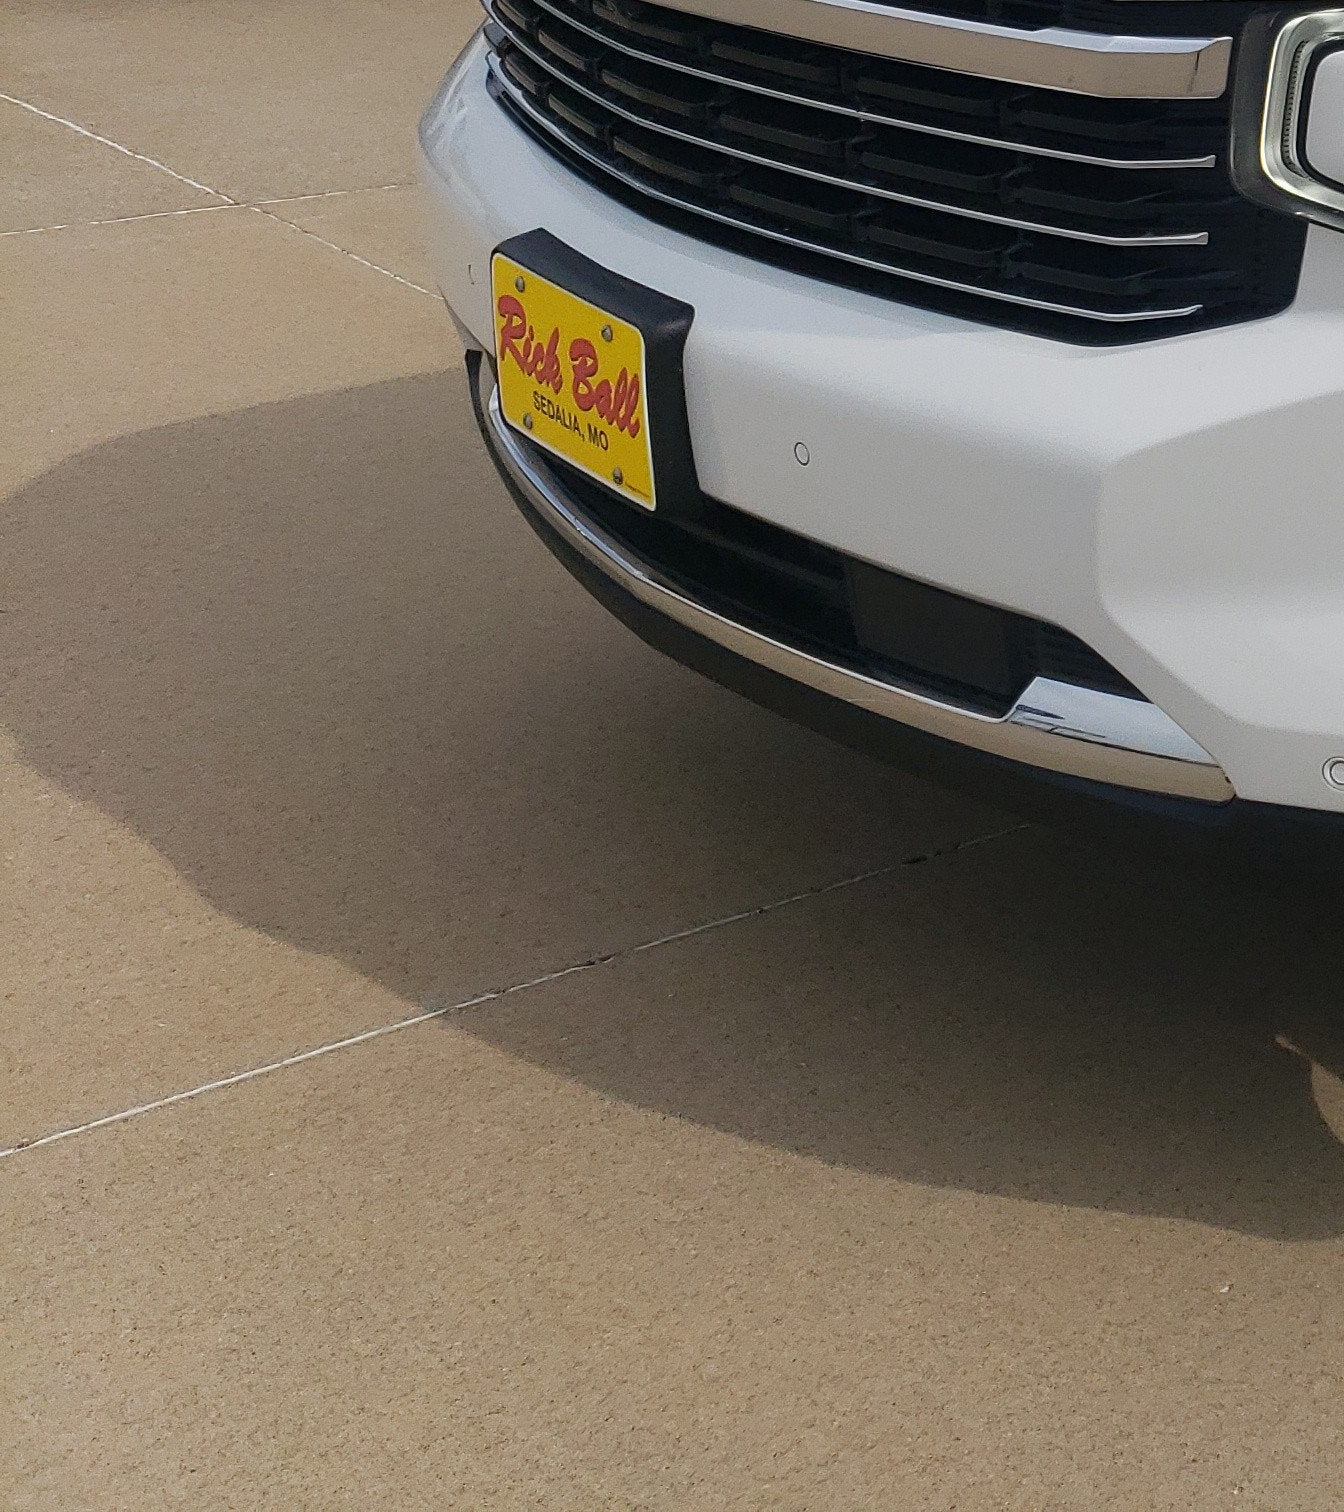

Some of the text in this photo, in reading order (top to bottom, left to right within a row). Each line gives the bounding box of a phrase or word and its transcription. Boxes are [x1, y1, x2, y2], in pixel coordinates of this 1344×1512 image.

[498, 295, 640, 438] Rick Ball
[532, 391, 609, 451] SEDALIA, MO
